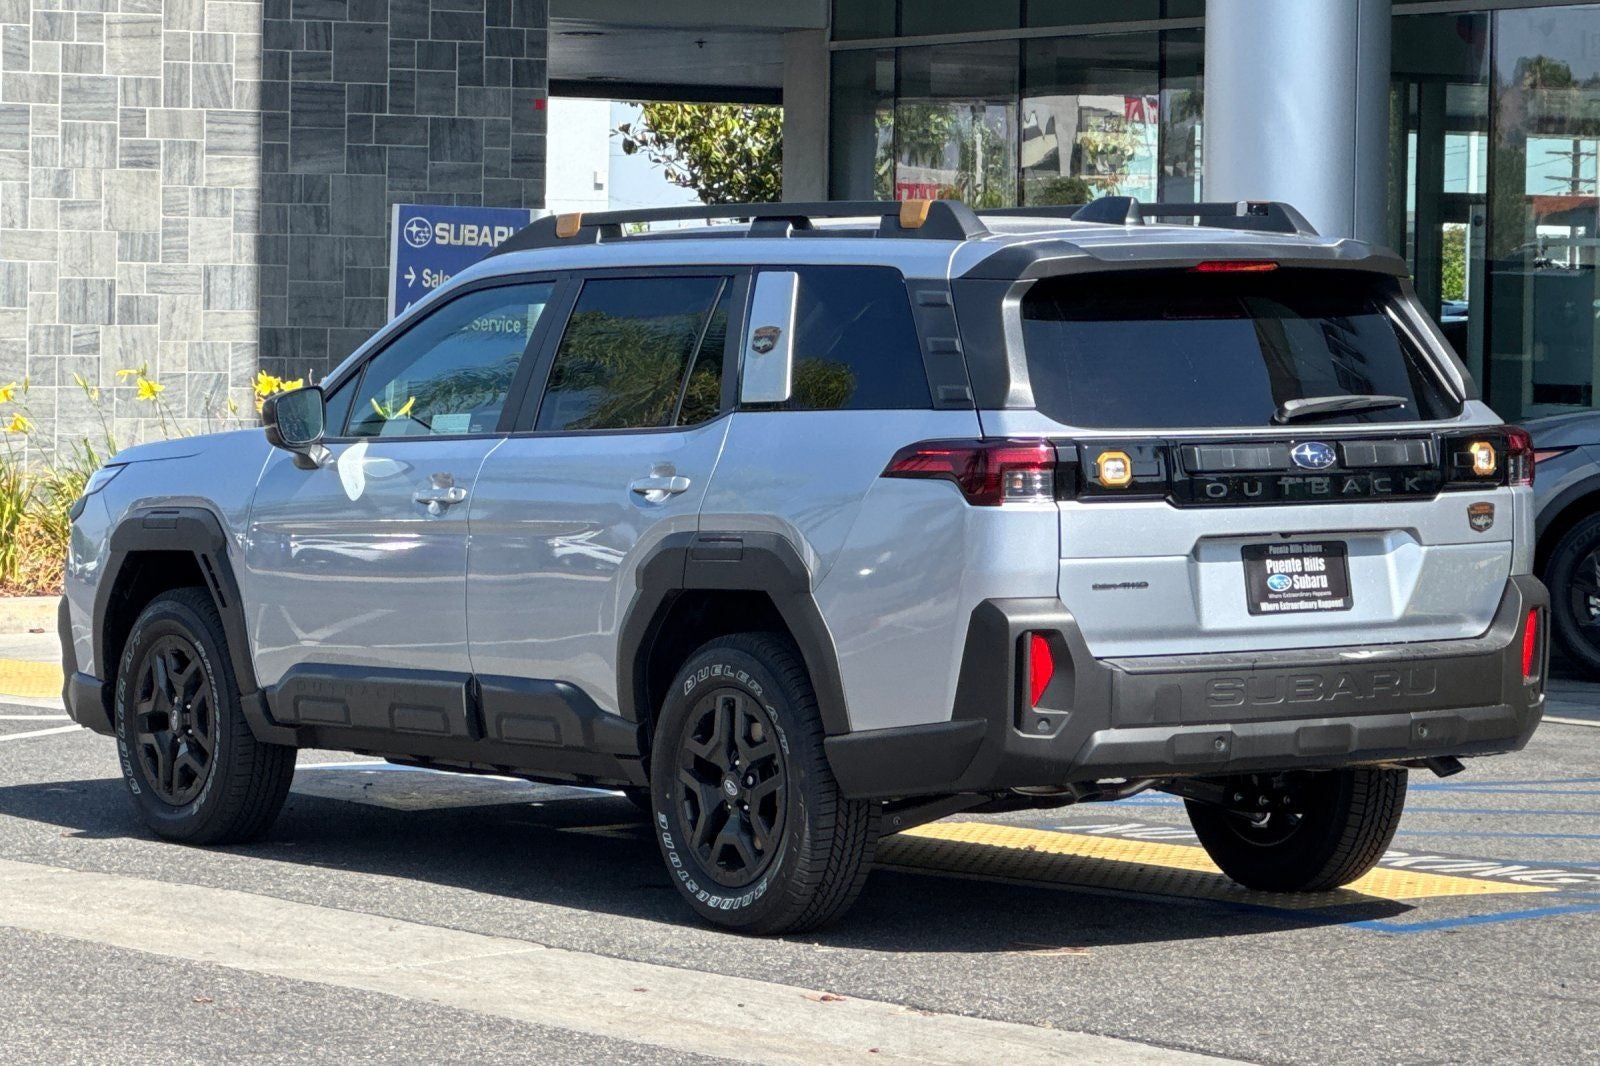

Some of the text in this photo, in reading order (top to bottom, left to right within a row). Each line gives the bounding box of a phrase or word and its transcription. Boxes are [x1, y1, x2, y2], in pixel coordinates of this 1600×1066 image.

[1205, 476, 1421, 498] OUTBACK
[1266, 556, 1326, 574] Puente Hills
[1292, 574, 1328, 590] Subaru
[1260, 602, 1279, 611] Where
[684, 664, 763, 697] DUELER
[1206, 667, 1438, 708] SUBARU
[657, 811, 768, 910] BRIDGESTONE
